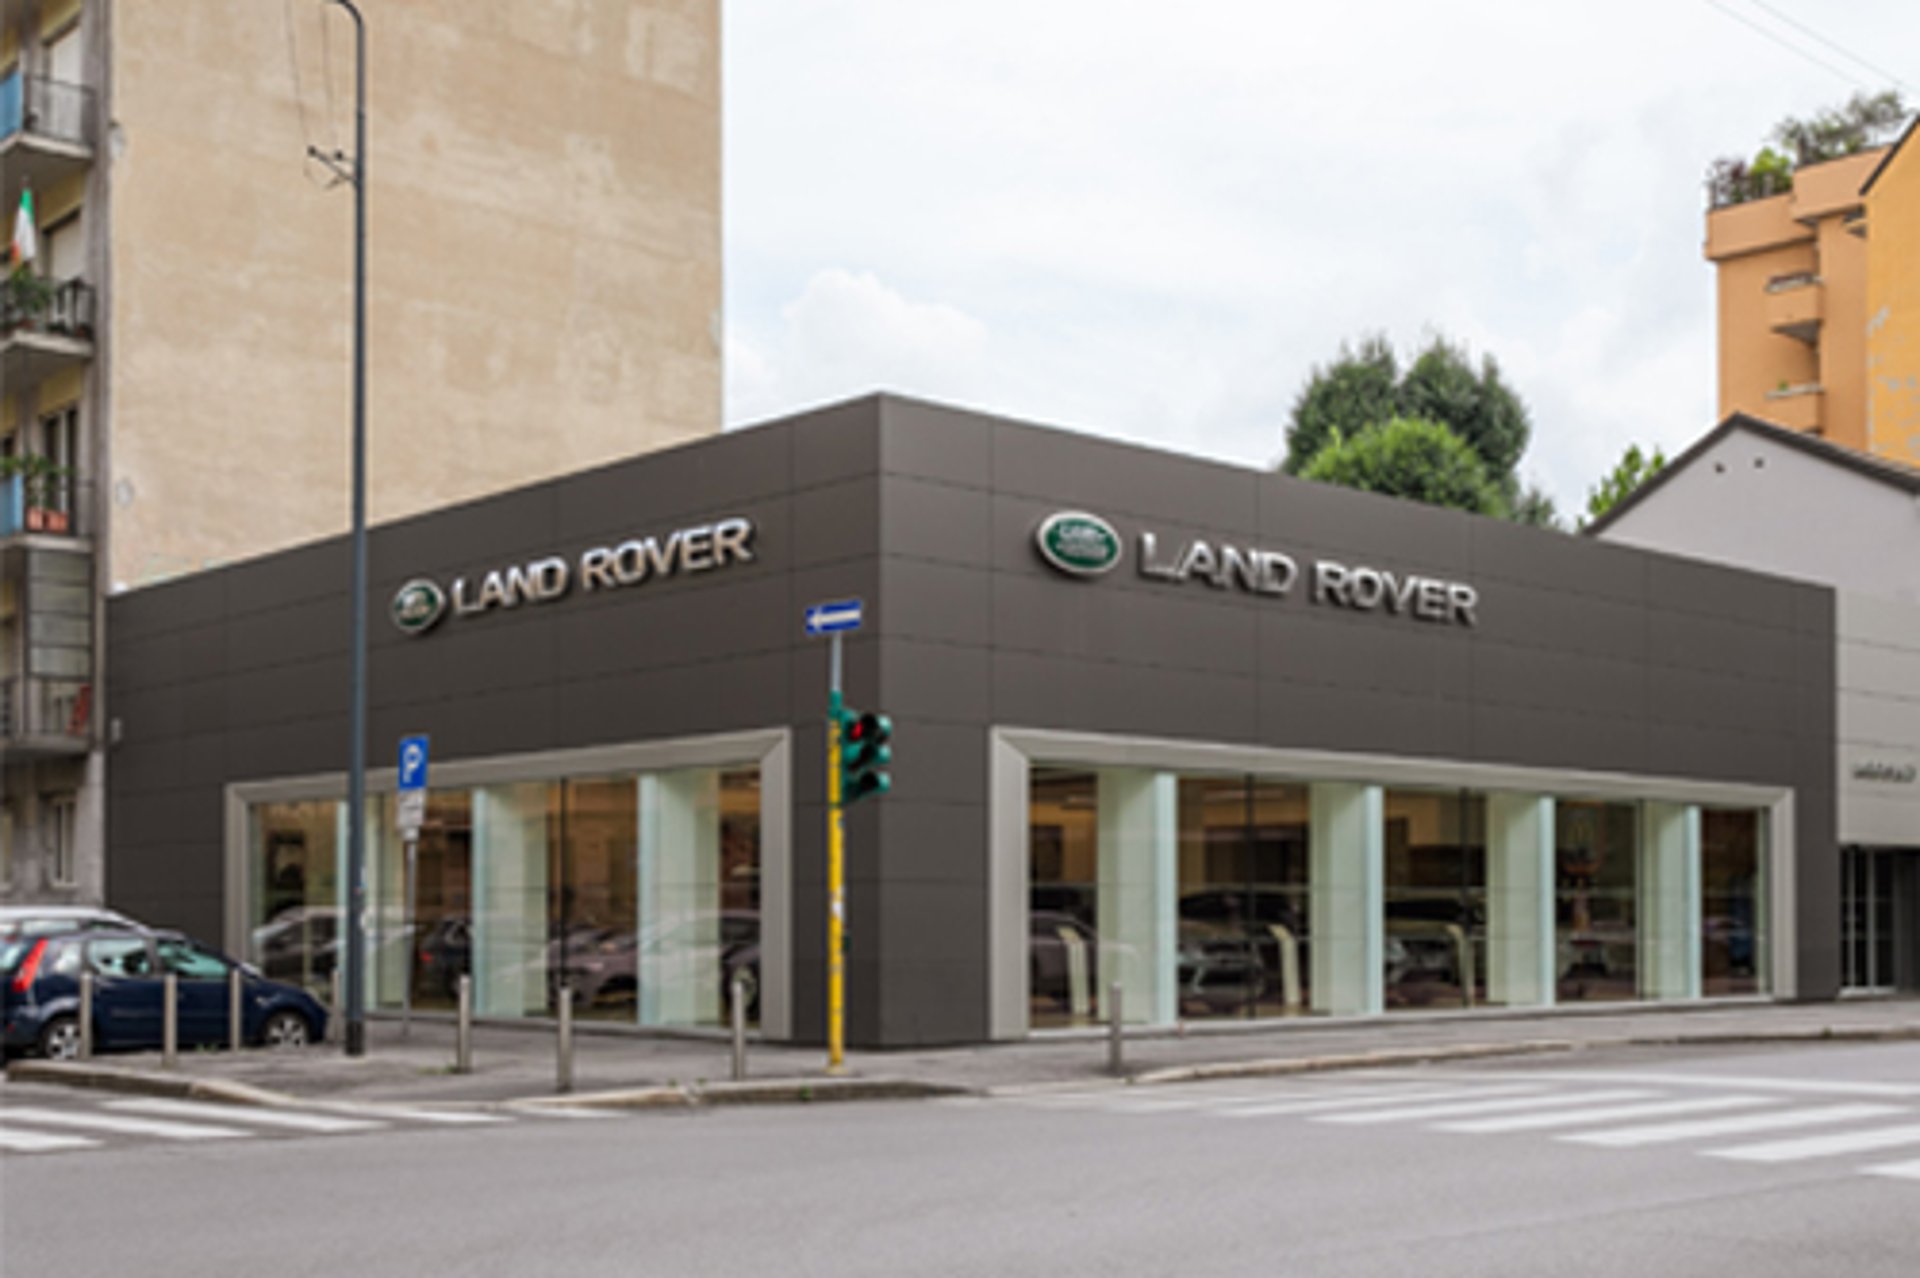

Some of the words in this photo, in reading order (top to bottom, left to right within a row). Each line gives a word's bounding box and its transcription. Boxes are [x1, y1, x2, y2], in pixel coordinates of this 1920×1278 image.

[451, 556, 568, 615] LAND
[581, 517, 753, 590] ROVER
[1141, 532, 1298, 594] LAND
[1313, 558, 1478, 625] ROVER
[403, 743, 424, 784] P
